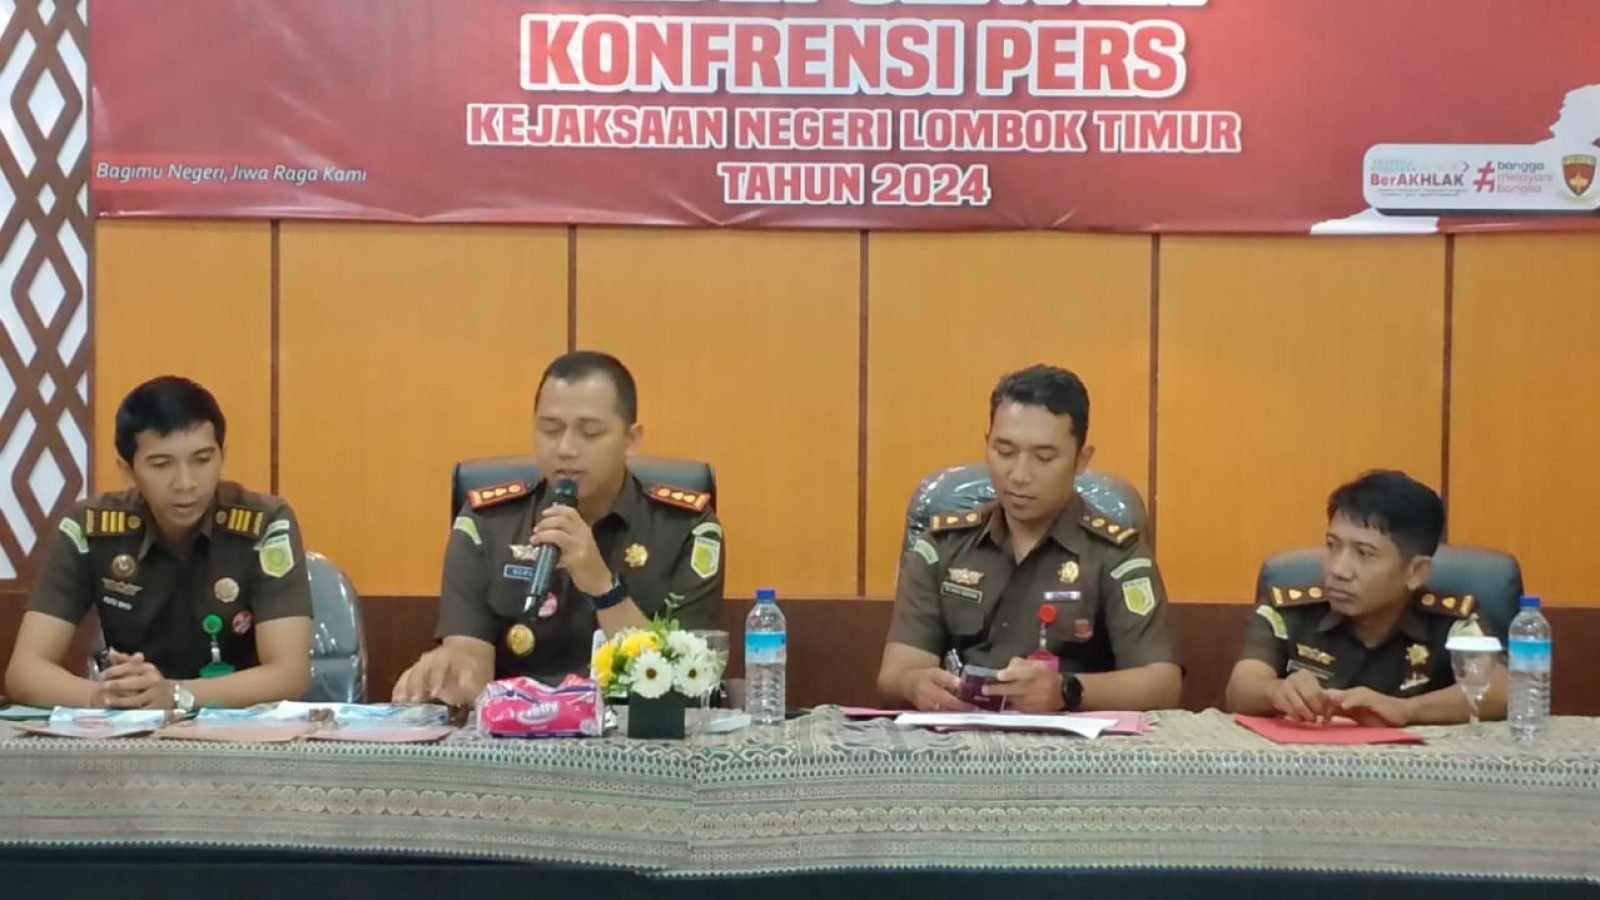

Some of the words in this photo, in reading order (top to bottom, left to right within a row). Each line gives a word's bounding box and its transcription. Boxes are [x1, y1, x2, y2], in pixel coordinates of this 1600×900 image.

[520, 14, 963, 96] KONFRENSI
[976, 20, 1187, 98] PERS
[466, 103, 727, 149] KEJAKSAAN
[734, 108, 893, 150] NEGERI
[899, 109, 1087, 152] LOMBOK
[1093, 110, 1242, 153] TIMUR
[96, 162, 163, 183] Bagimu
[229, 165, 269, 180] Jiwa
[273, 165, 318, 185] Raga
[323, 166, 367, 182] Kami
[1370, 173, 1464, 186] BerAKHLAK
[1497, 161, 1545, 173] bangga
[717, 163, 864, 203] TAHUN
[870, 163, 992, 206] 2024
